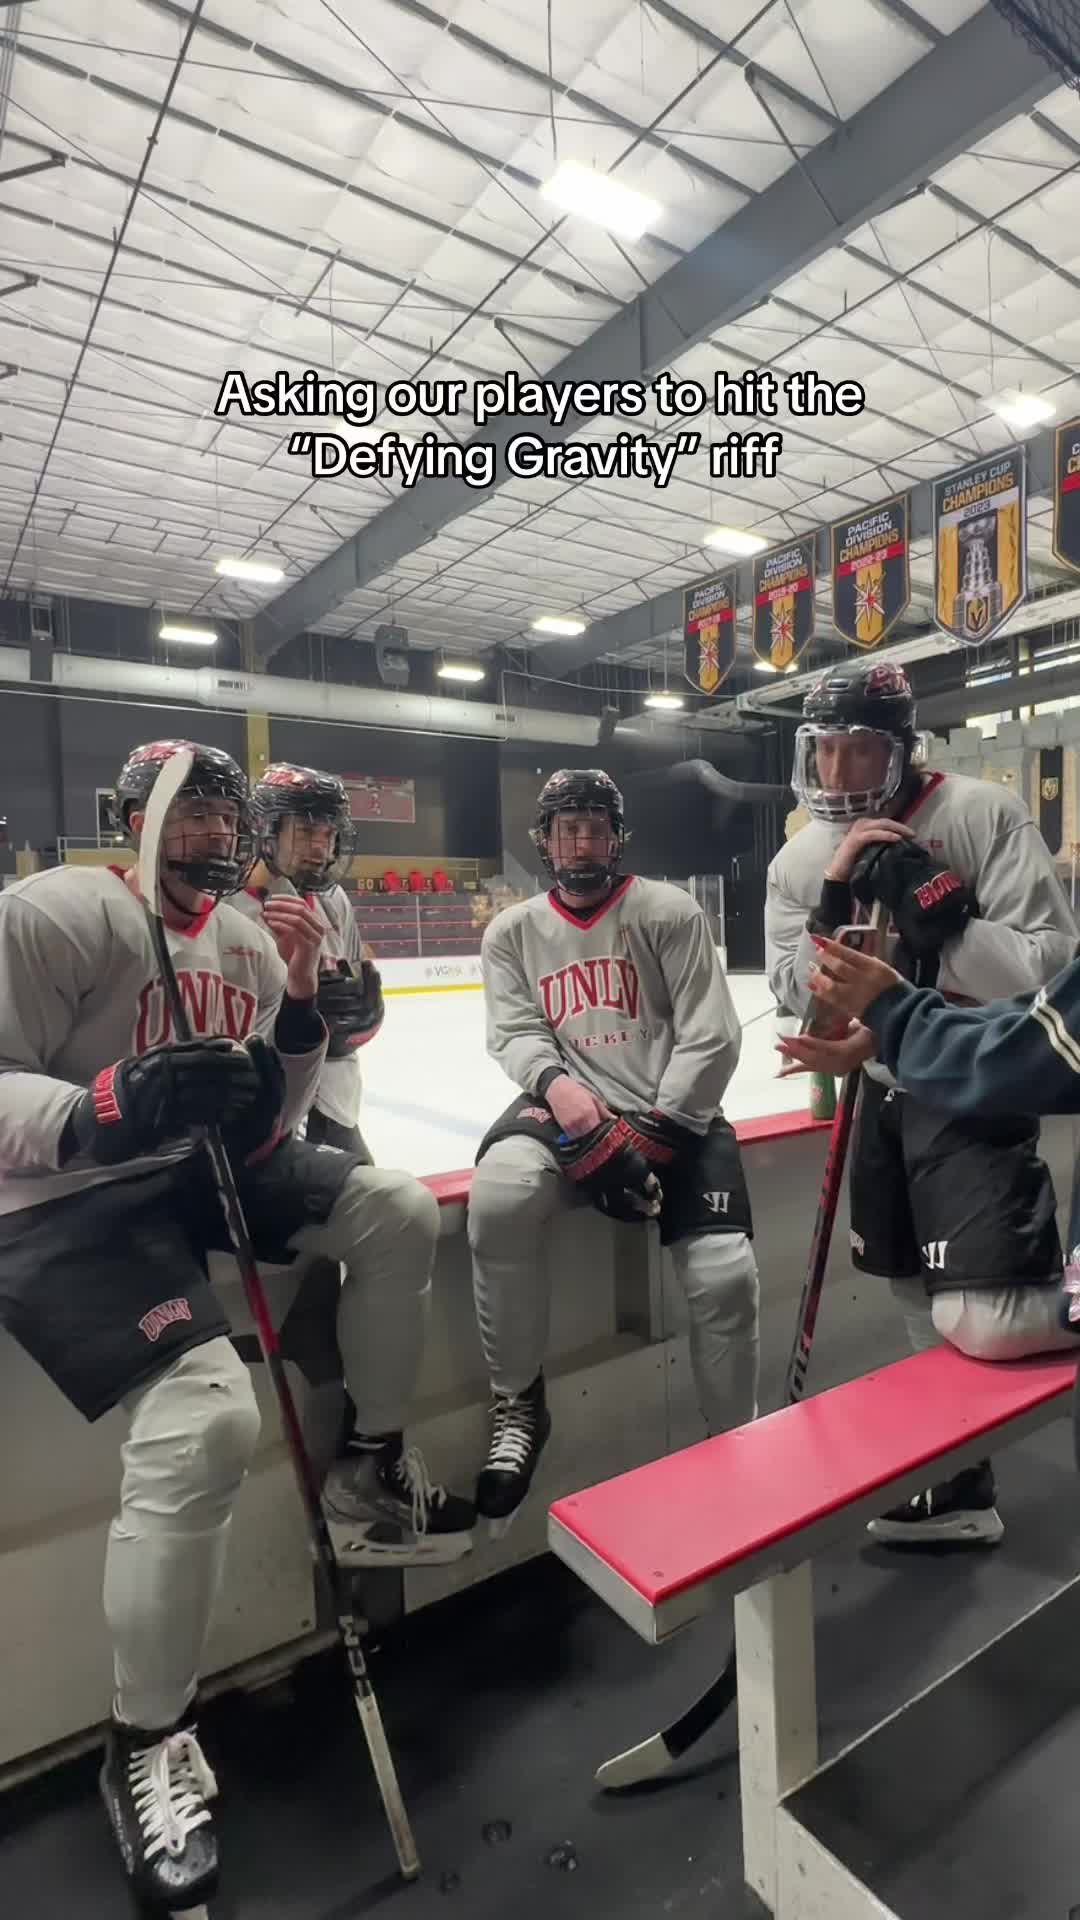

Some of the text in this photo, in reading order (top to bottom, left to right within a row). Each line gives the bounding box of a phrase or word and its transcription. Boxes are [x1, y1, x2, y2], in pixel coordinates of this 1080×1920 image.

[943, 472, 1014, 513] CHAMPIONS
[944, 460, 1011, 497] STANLEY CUP
[845, 520, 893, 547] DIVISION
[847, 511, 890, 537] PACIFIC
[766, 548, 801, 569] PACIFIC
[840, 528, 899, 563] CHAMPIONS
[759, 564, 808, 592] CHAMPIONS
[764, 556, 803, 578] DIVISION
[538, 957, 640, 1030] UNLV
[567, 1028, 648, 1050] OCKEY
[138, 1297, 193, 1342] UNLV
